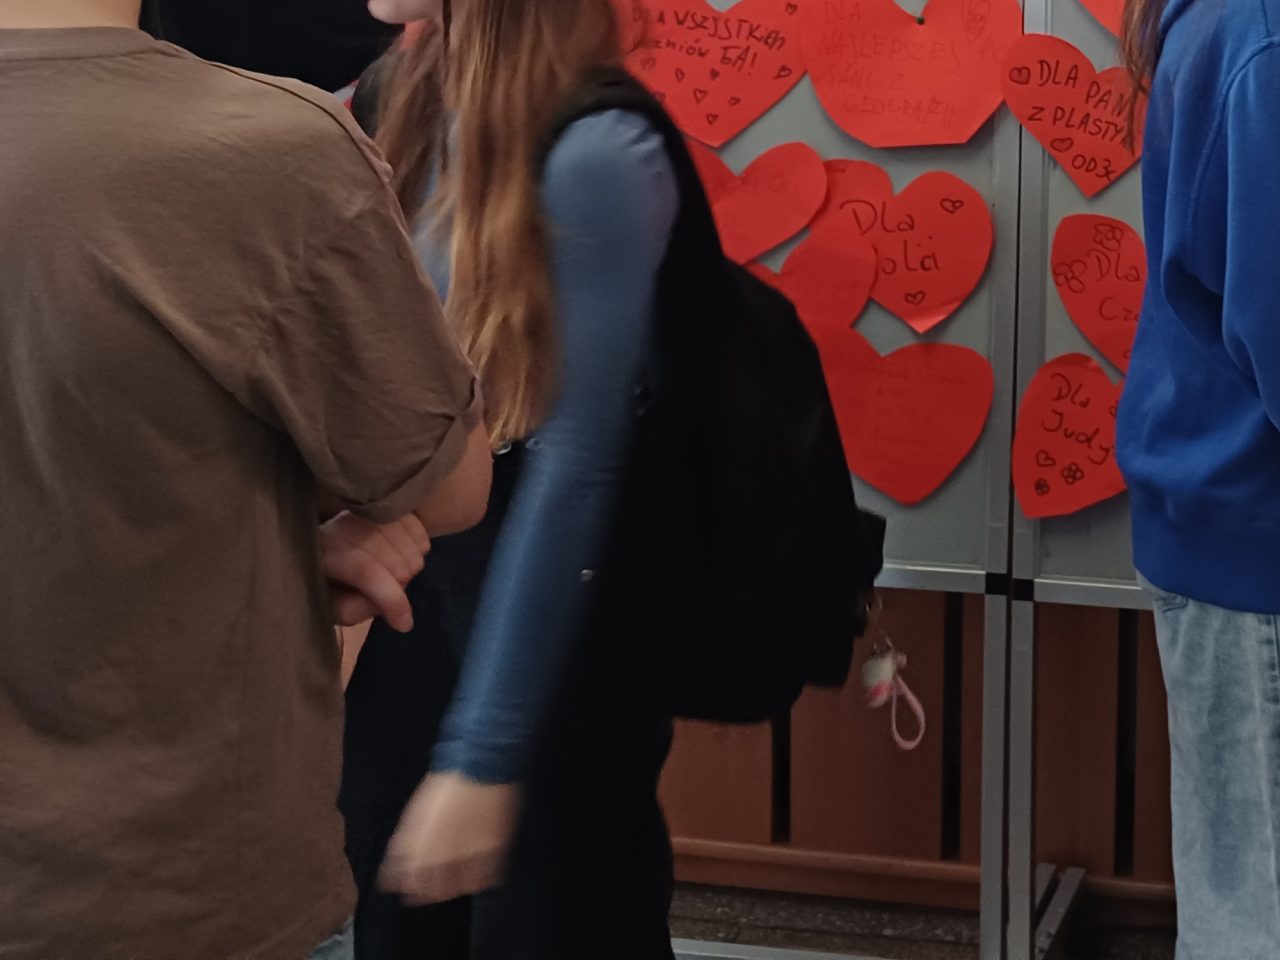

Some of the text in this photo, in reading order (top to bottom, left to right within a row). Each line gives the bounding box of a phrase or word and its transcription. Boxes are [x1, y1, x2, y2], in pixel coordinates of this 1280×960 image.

[1038, 60, 1079, 89] DLA
[839, 200, 915, 236] Dla
[1087, 248, 1141, 282] Dla
[1051, 373, 1091, 409] Dla
